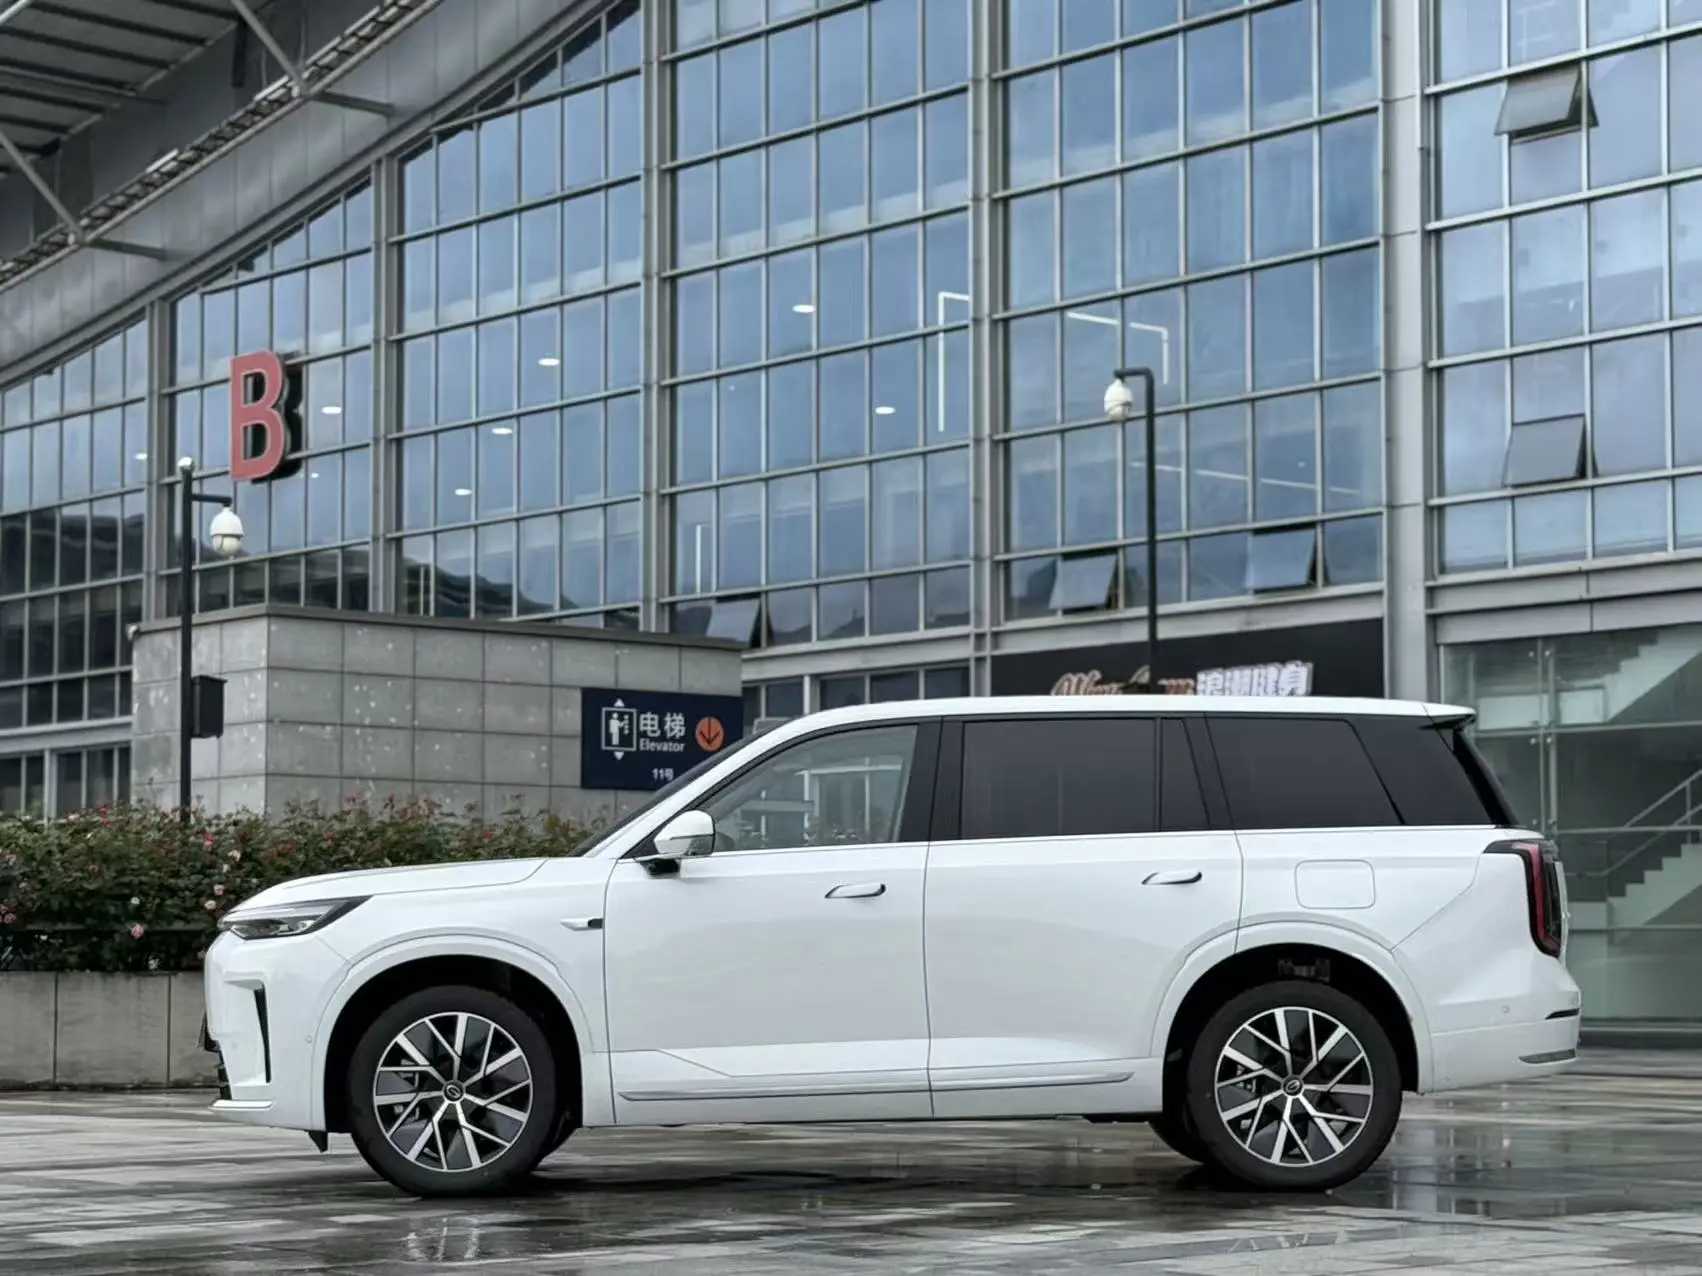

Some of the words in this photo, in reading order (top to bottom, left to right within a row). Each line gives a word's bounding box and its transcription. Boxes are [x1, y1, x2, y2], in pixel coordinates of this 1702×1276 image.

[229, 350, 285, 481] B
[639, 711, 686, 739] 电梯
[639, 738, 686, 752] Elevator
